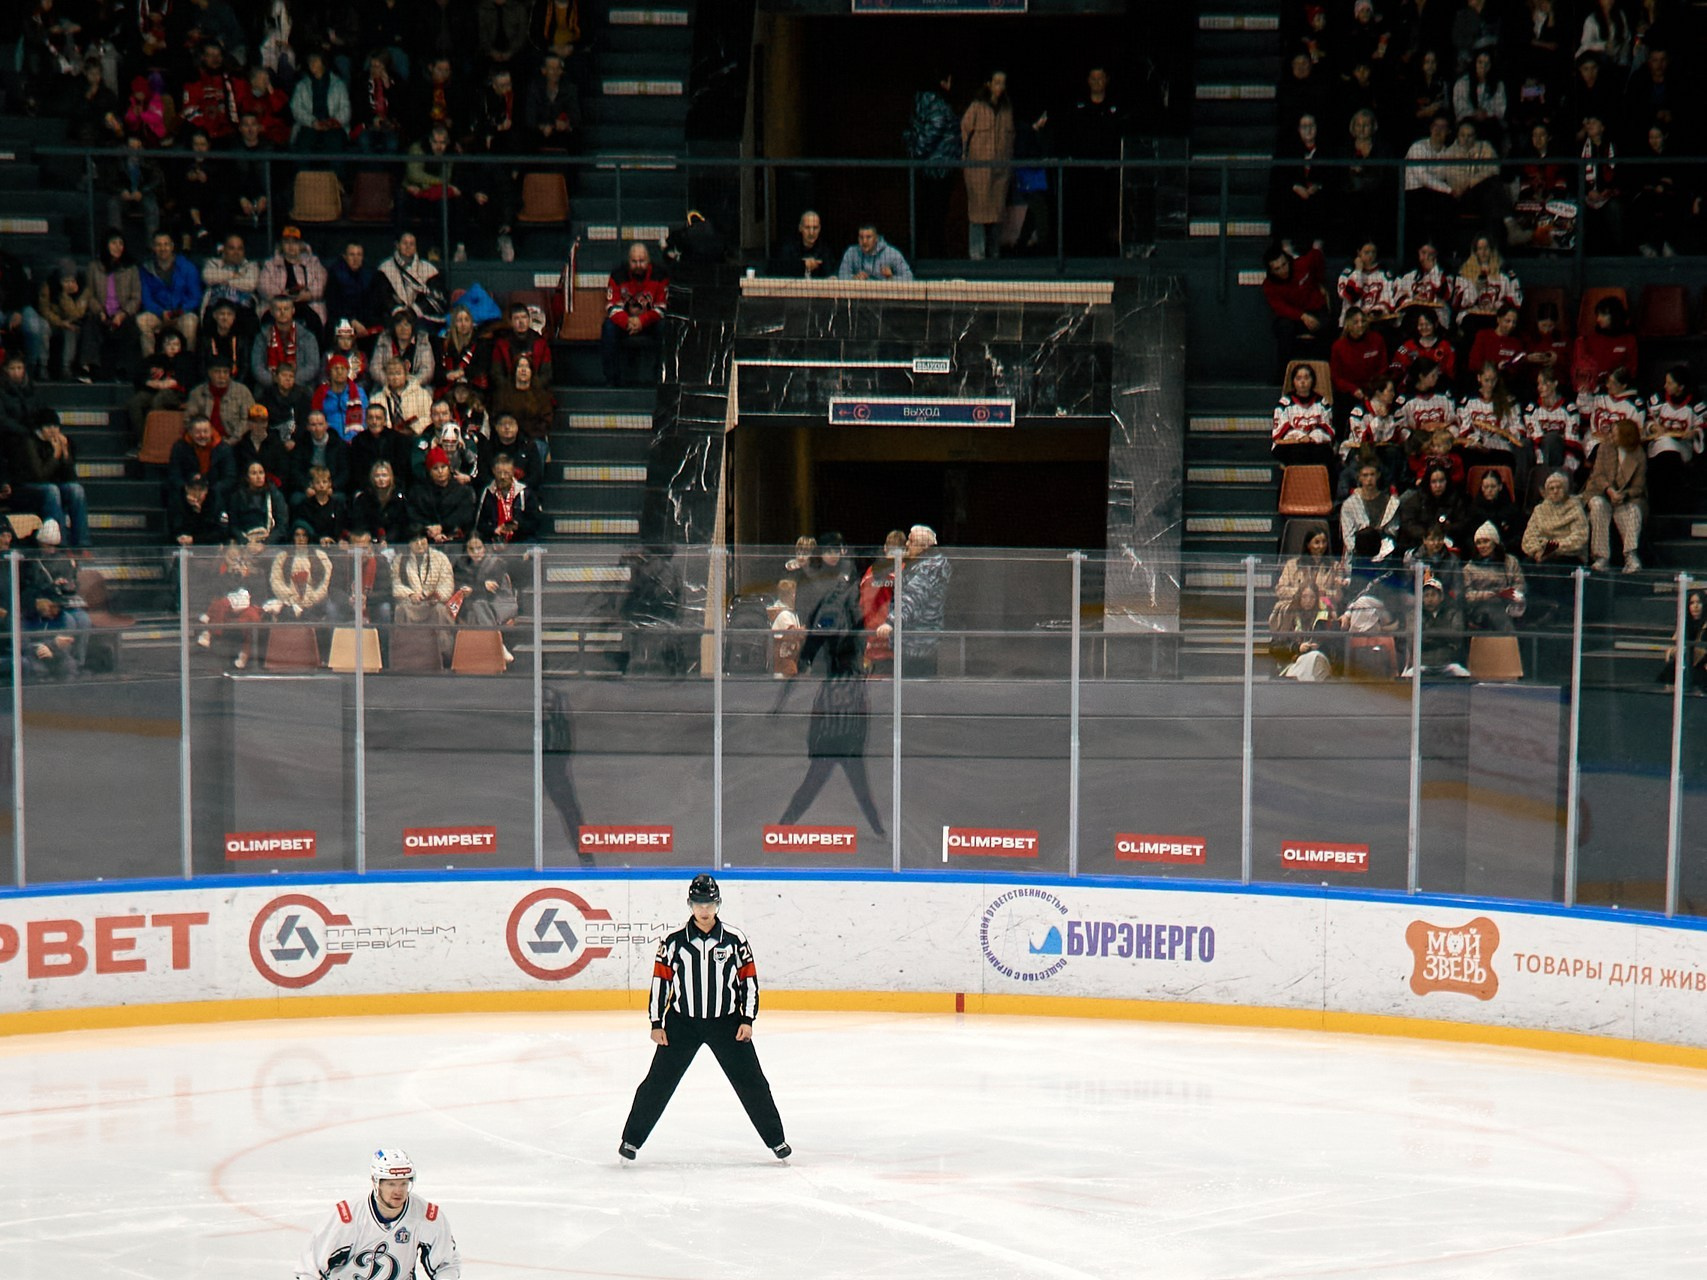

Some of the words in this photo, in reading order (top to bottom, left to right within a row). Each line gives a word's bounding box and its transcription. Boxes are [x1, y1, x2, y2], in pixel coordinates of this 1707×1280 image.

[903, 407, 940, 417] ВЫХОД
[227, 838, 314, 853] OLIMPBET
[405, 833, 494, 848] OLIMPBET
[581, 833, 671, 846] OLIMPBET
[765, 833, 854, 846] OLIMPBET
[948, 835, 1036, 850] OLIMPBET
[1117, 841, 1204, 857] OLIMPBET
[1283, 849, 1367, 864] OLIMPBET
[985, 888, 1069, 918] ОТВЕТСТВЕННОСТЬЮ
[326, 925, 456, 938] ПЛАТИНУМ
[585, 923, 680, 932] ПЛАТИН
[326, 939, 416, 950] СЕРВИС
[585, 936, 662, 944] СЕРВИ
[1067, 920, 1216, 963] БУРЭНЕРГО
[1427, 928, 1481, 958] МОЙ
[1022, 958, 1068, 981] ОБЩЕСТВО
[1423, 956, 1487, 984] ЗВЕРЬ
[1513, 953, 1602, 980] ТОВАРЫ
[1609, 963, 1651, 986] ДЛЯ
